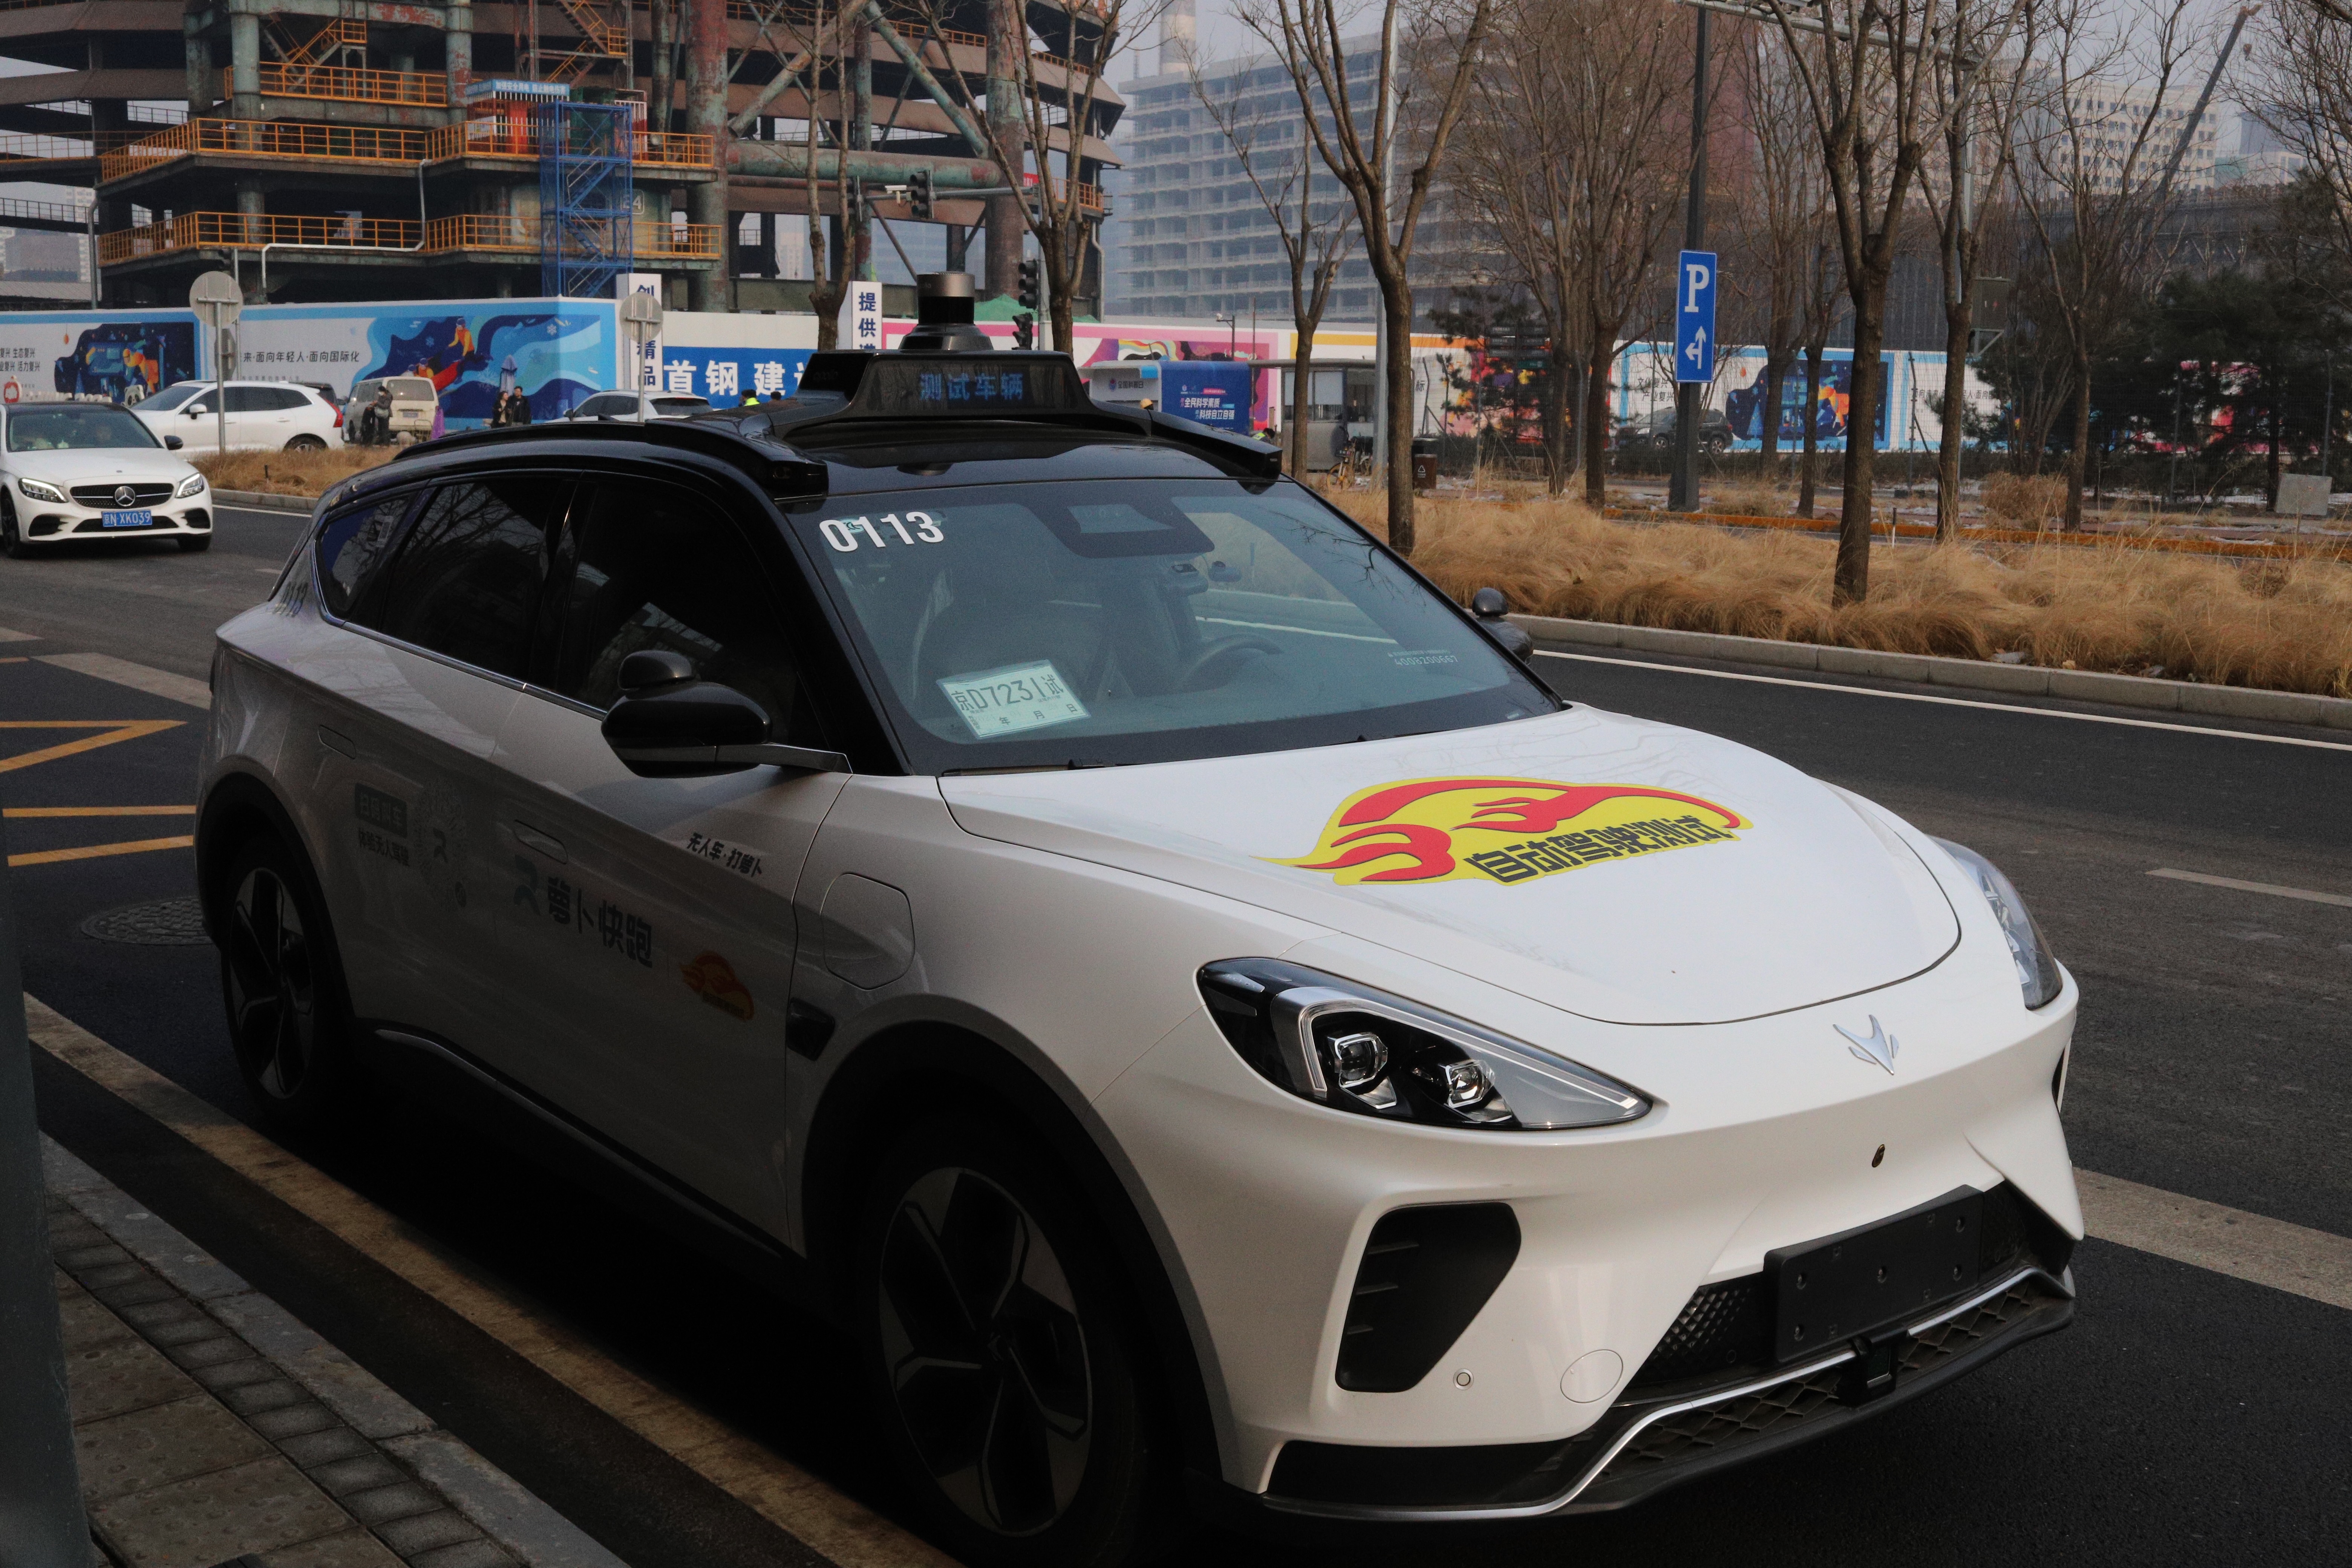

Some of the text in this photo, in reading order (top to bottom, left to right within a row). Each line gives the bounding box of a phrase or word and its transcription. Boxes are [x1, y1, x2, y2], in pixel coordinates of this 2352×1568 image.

[1685, 264, 1709, 312] P
[859, 292, 876, 349] 提供
[13, 348, 35, 358] 生态复兴
[18, 361, 40, 371] 活力复兴
[920, 373, 1023, 401] 测试车辆
[1199, 410, 1235, 420] 科技自立自强
[819, 511, 944, 552] 0113
[1395, 655, 1458, 666] 4008200667
[951, 674, 1064, 711] 京D7231试
[999, 717, 1011, 725] 年
[1033, 710, 1045, 719] 月
[1066, 704, 1078, 712] 日
[1462, 815, 1732, 883] 自动驾驶测试
[548, 876, 652, 968] 萝卜快跑
